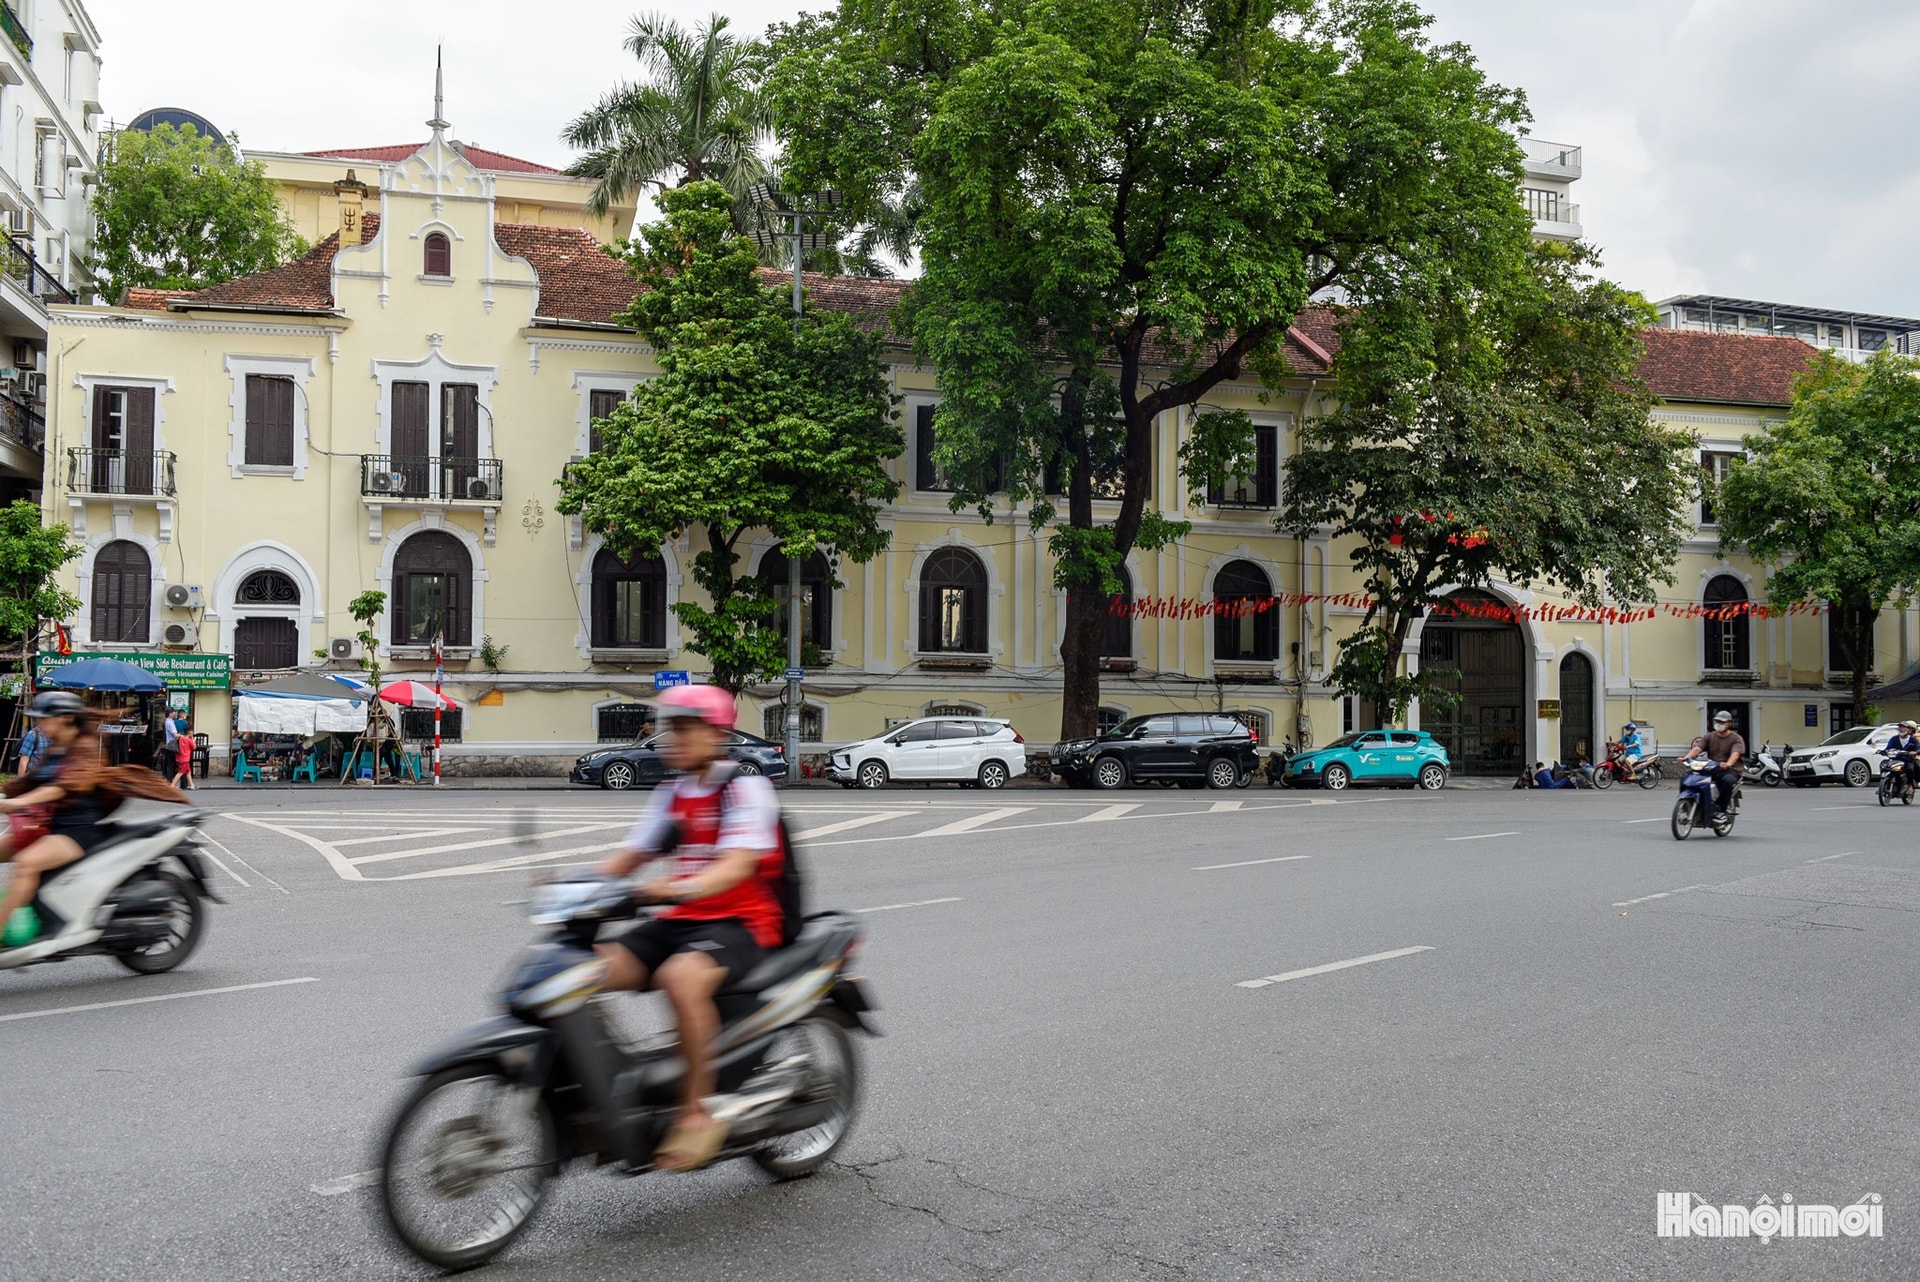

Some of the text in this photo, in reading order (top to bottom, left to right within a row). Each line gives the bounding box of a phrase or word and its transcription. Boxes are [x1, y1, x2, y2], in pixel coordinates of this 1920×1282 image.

[41, 655, 72, 665] Quán
[140, 658, 154, 669] View
[156, 658, 170, 669] Side
[171, 658, 205, 670] Restaurant
[206, 660, 212, 670] &
[213, 659, 227, 670] Cafe
